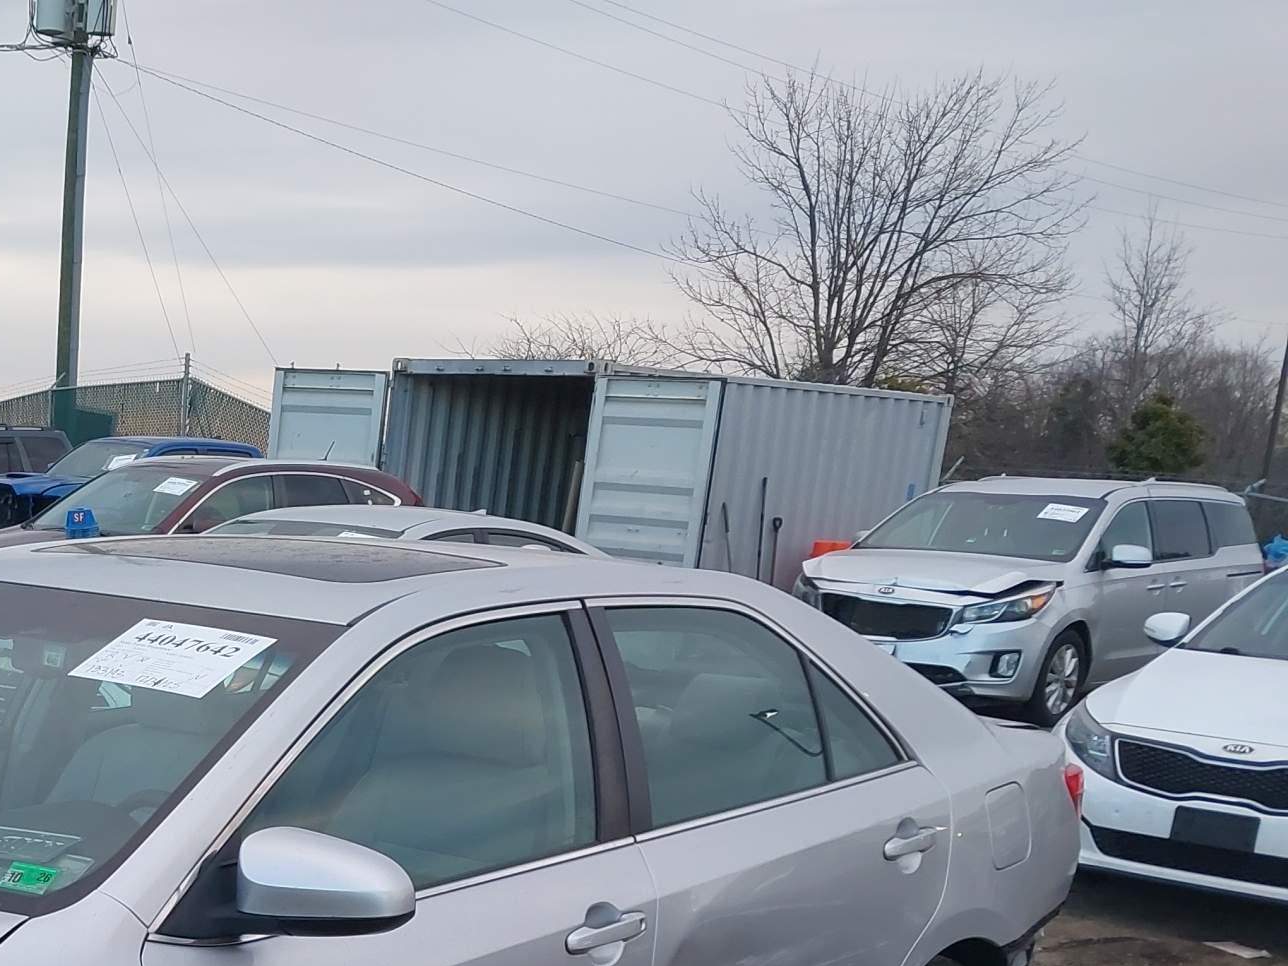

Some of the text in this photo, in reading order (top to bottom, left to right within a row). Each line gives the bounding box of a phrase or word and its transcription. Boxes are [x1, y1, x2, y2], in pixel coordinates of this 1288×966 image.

[135, 631, 241, 658] 44047642
[1223, 744, 1253, 754] KIA
[8, 872, 23, 883] 10
